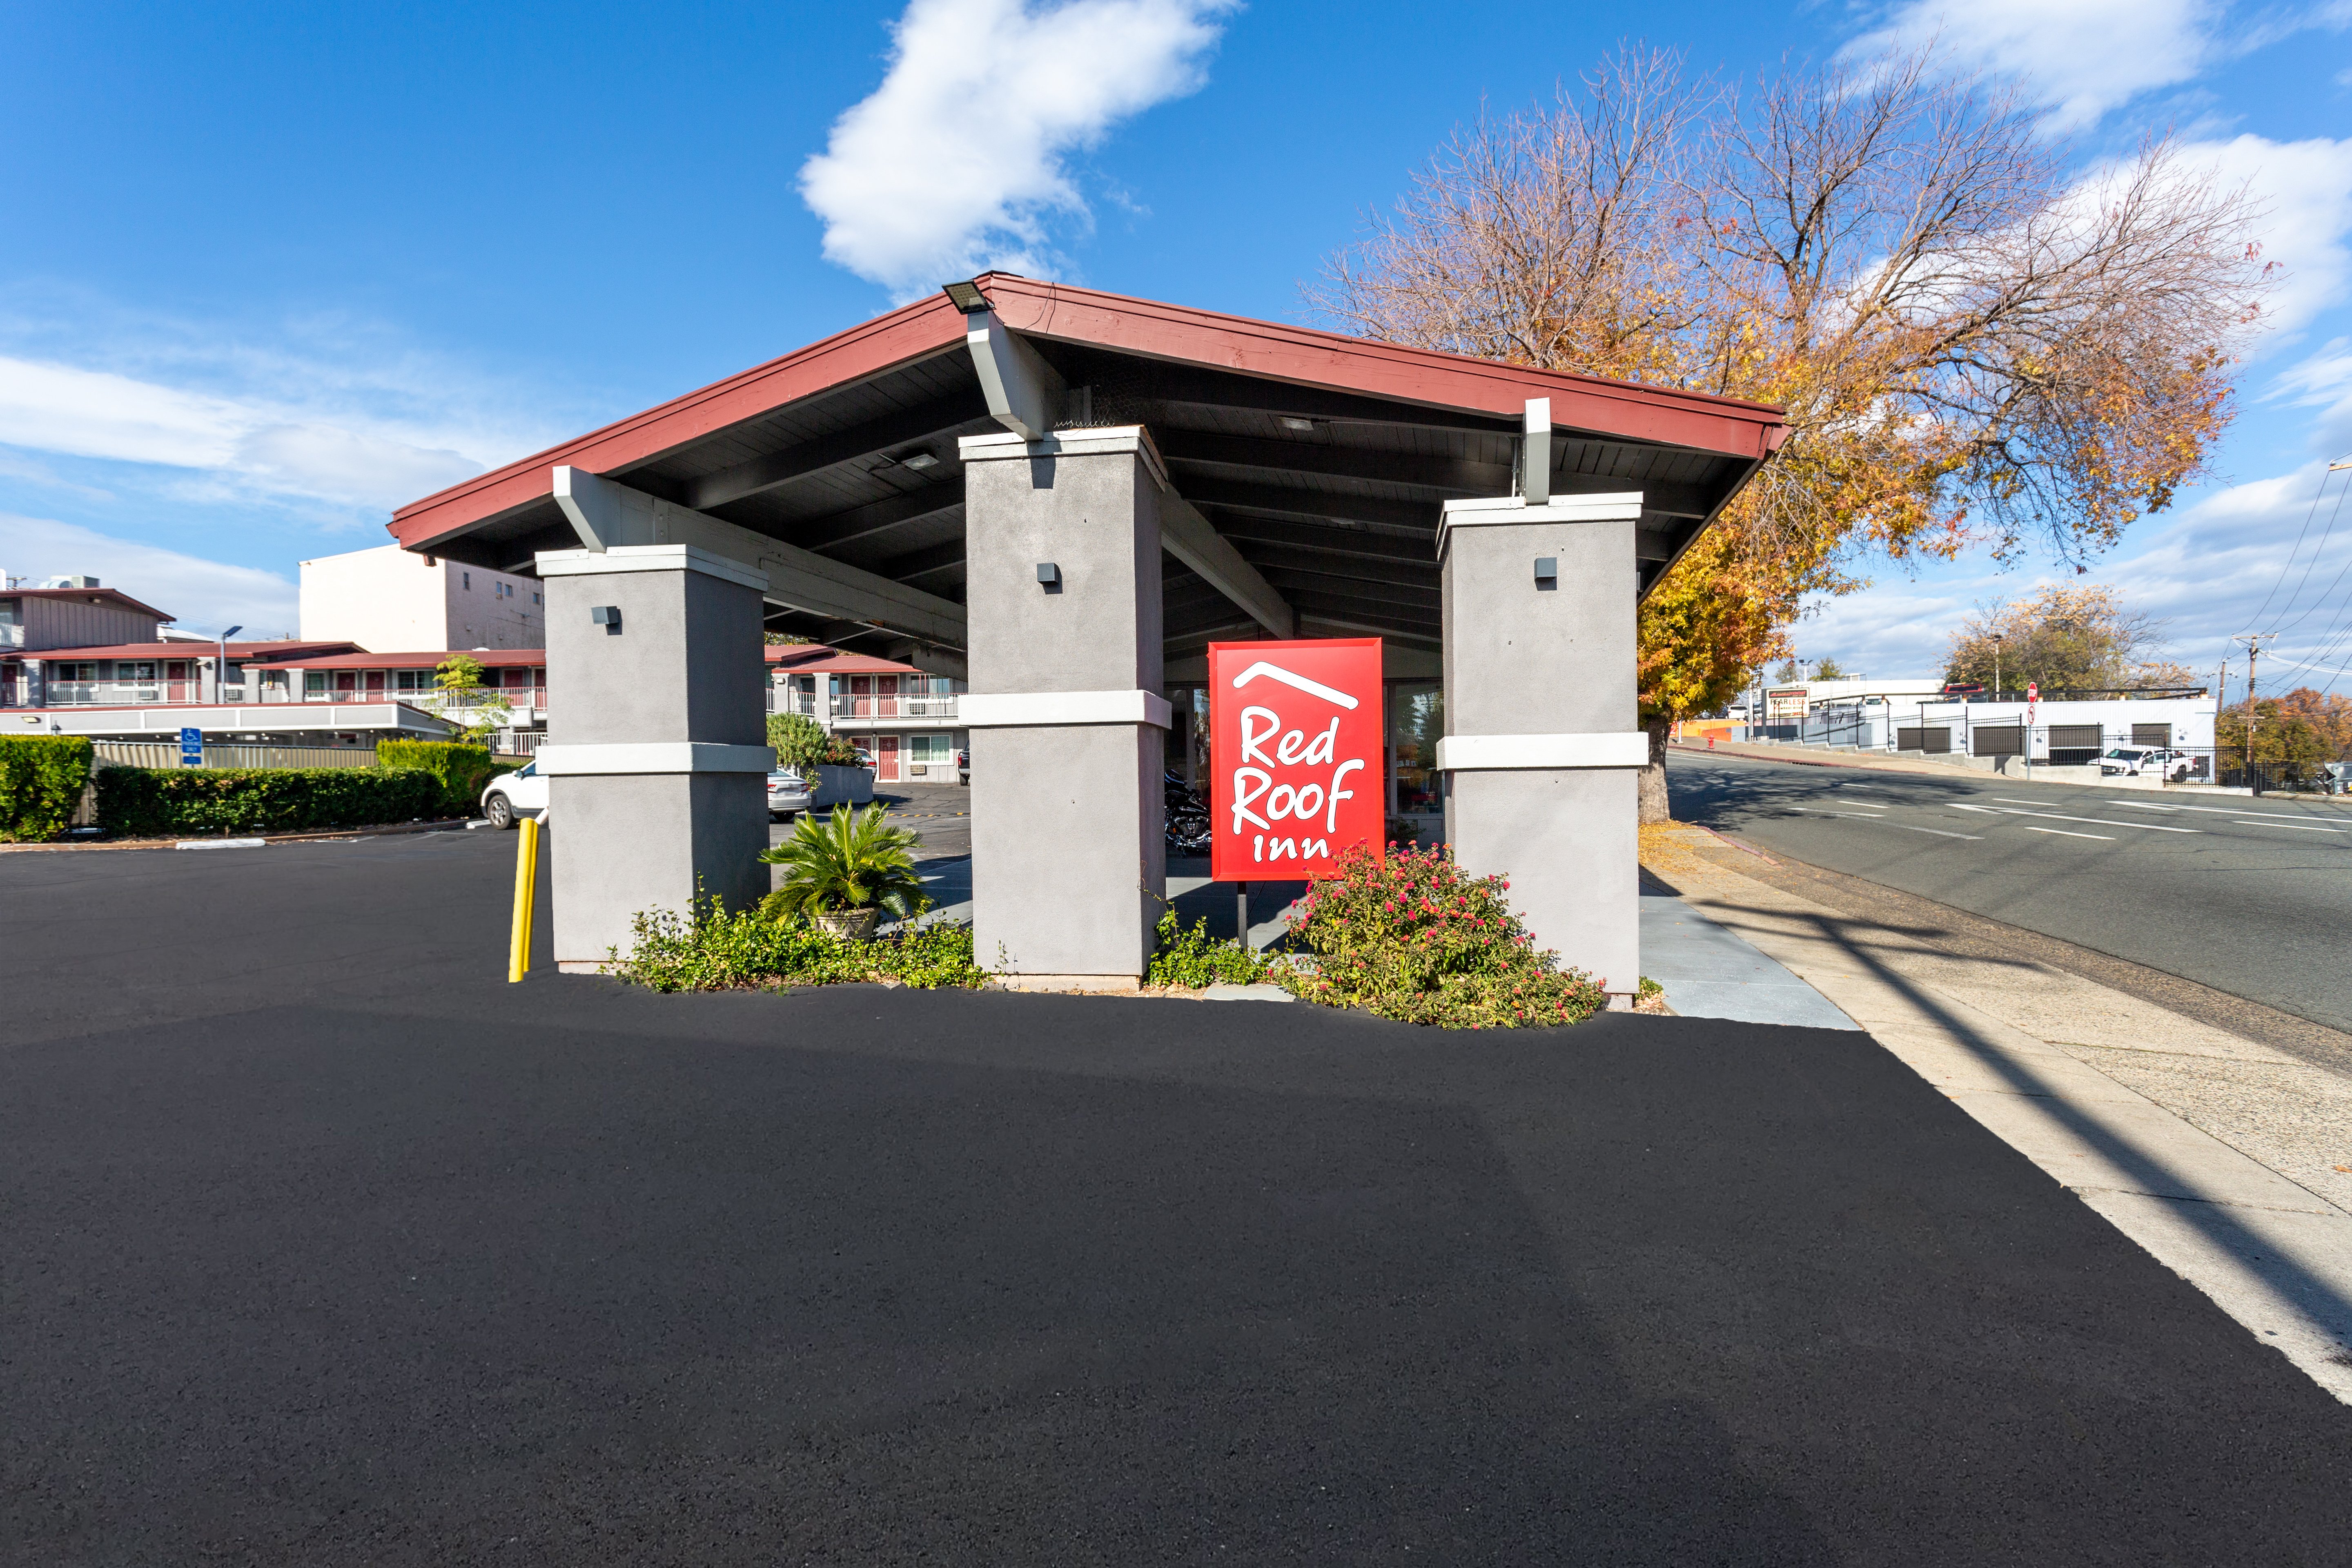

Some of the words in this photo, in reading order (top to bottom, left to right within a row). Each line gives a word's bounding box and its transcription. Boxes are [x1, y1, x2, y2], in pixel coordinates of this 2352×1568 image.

[2028, 689, 2037, 697] STOP
[1240, 706, 1340, 768] Red
[1231, 759, 1365, 835] Roof
[1254, 834, 1330, 862] inn
